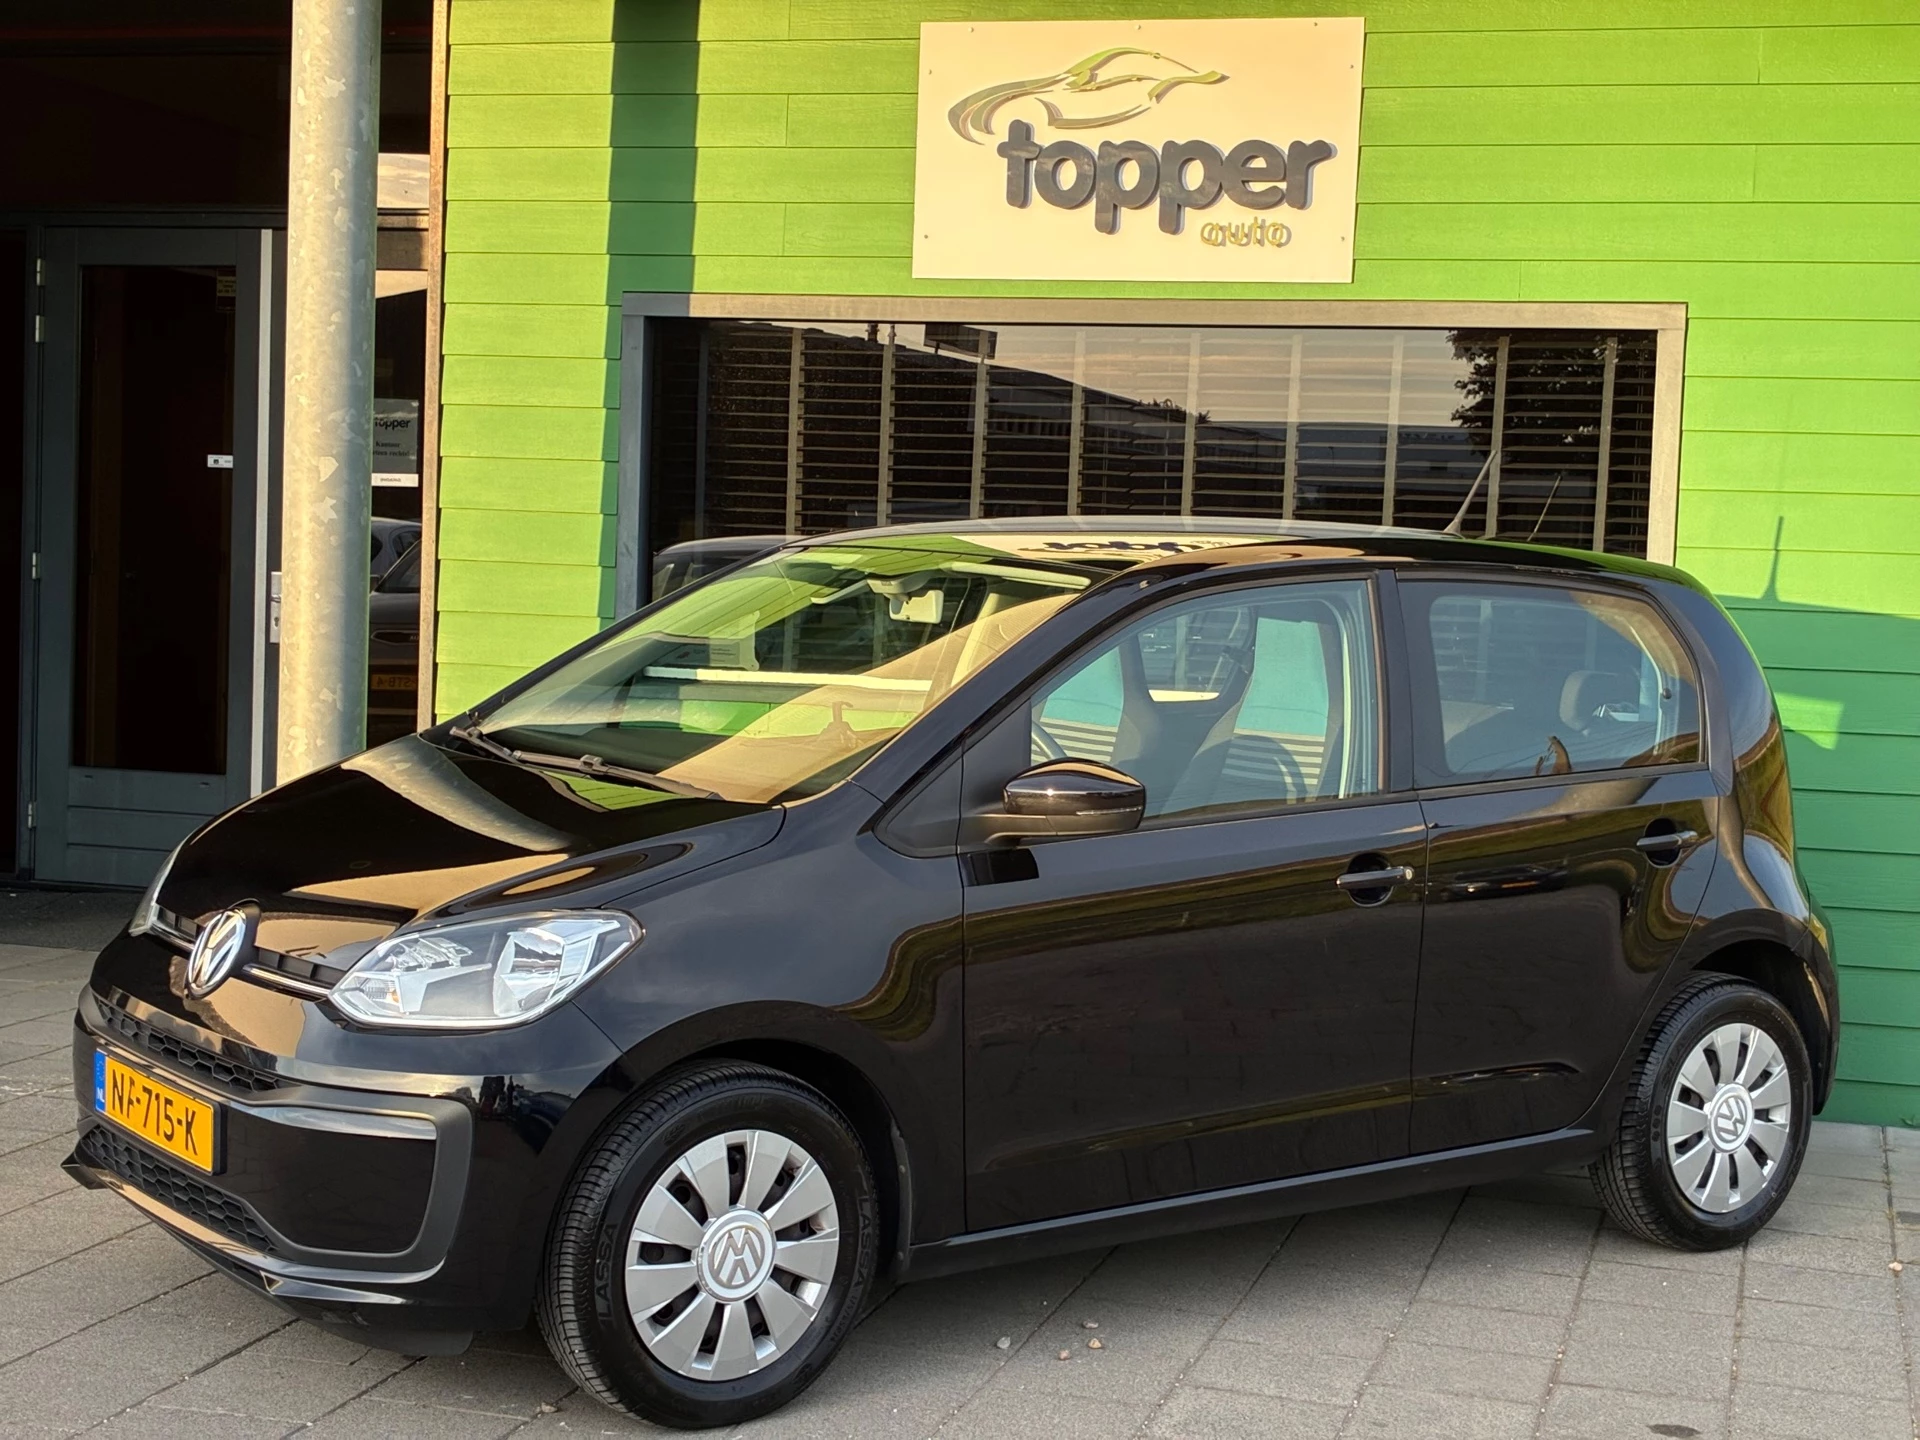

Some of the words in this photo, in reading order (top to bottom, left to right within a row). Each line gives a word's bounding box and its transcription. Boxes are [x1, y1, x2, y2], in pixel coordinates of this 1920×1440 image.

[997, 119, 1338, 235] topper
[1201, 216, 1288, 246] auto
[112, 1069, 198, 1156] NF-715-K
[595, 1224, 619, 1319] LASSA
